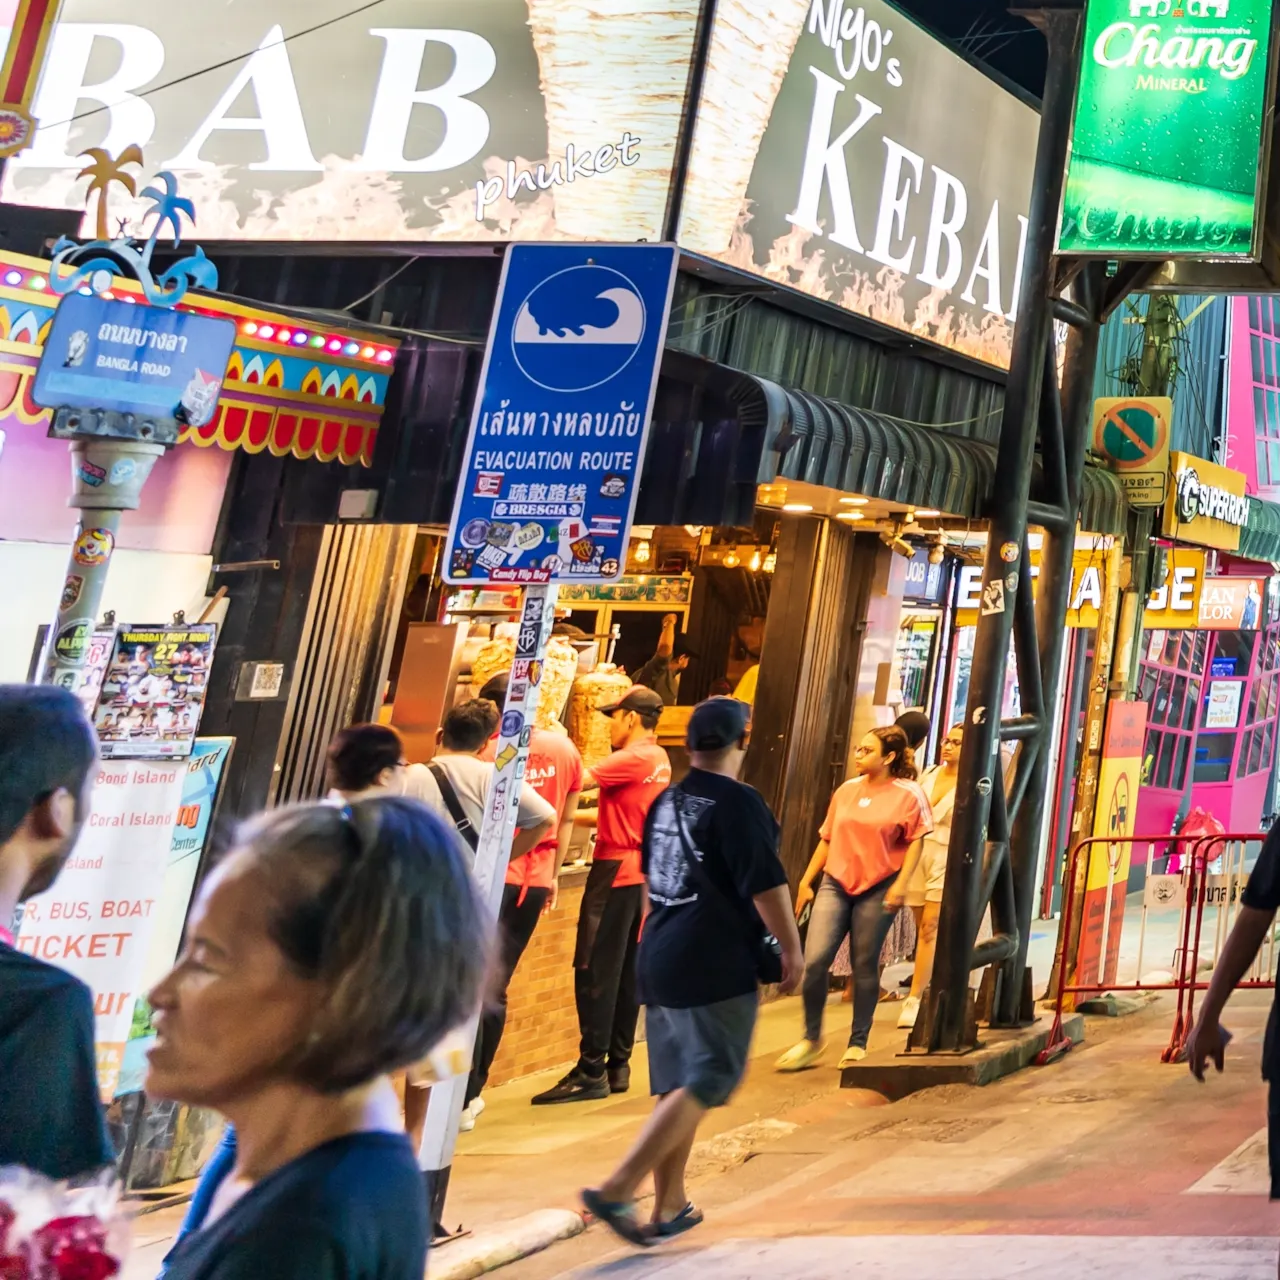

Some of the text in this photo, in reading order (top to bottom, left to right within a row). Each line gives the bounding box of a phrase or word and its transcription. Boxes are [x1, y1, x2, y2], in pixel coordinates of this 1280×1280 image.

[1093, 22, 1257, 80] Chang
[1136, 75, 1208, 94] MINERAL
[475, 131, 641, 221] phuket
[98, 323, 188, 354] ถนนบางลา
[97, 354, 172, 377] BANGLA ROAD
[481, 399, 640, 437] เส้นทางหลบภัย
[473, 451, 633, 470] EVACUATION ROUTE
[507, 483, 587, 501] 疏散路线
[1199, 484, 1250, 527] SUPERRICH
[492, 569, 517, 580] Candy
[601, 563, 618, 573] 42
[123, 632, 165, 642] THURSDAY
[154, 644, 178, 660] 27
[133, 770, 176, 784] Island
[524, 764, 555, 780] EBAB
[90, 812, 172, 827] Coral Island
[66, 857, 103, 869] sland
[50, 902, 92, 921] BUS,
[100, 899, 155, 918] BOAT
[17, 933, 133, 960] TICKET
